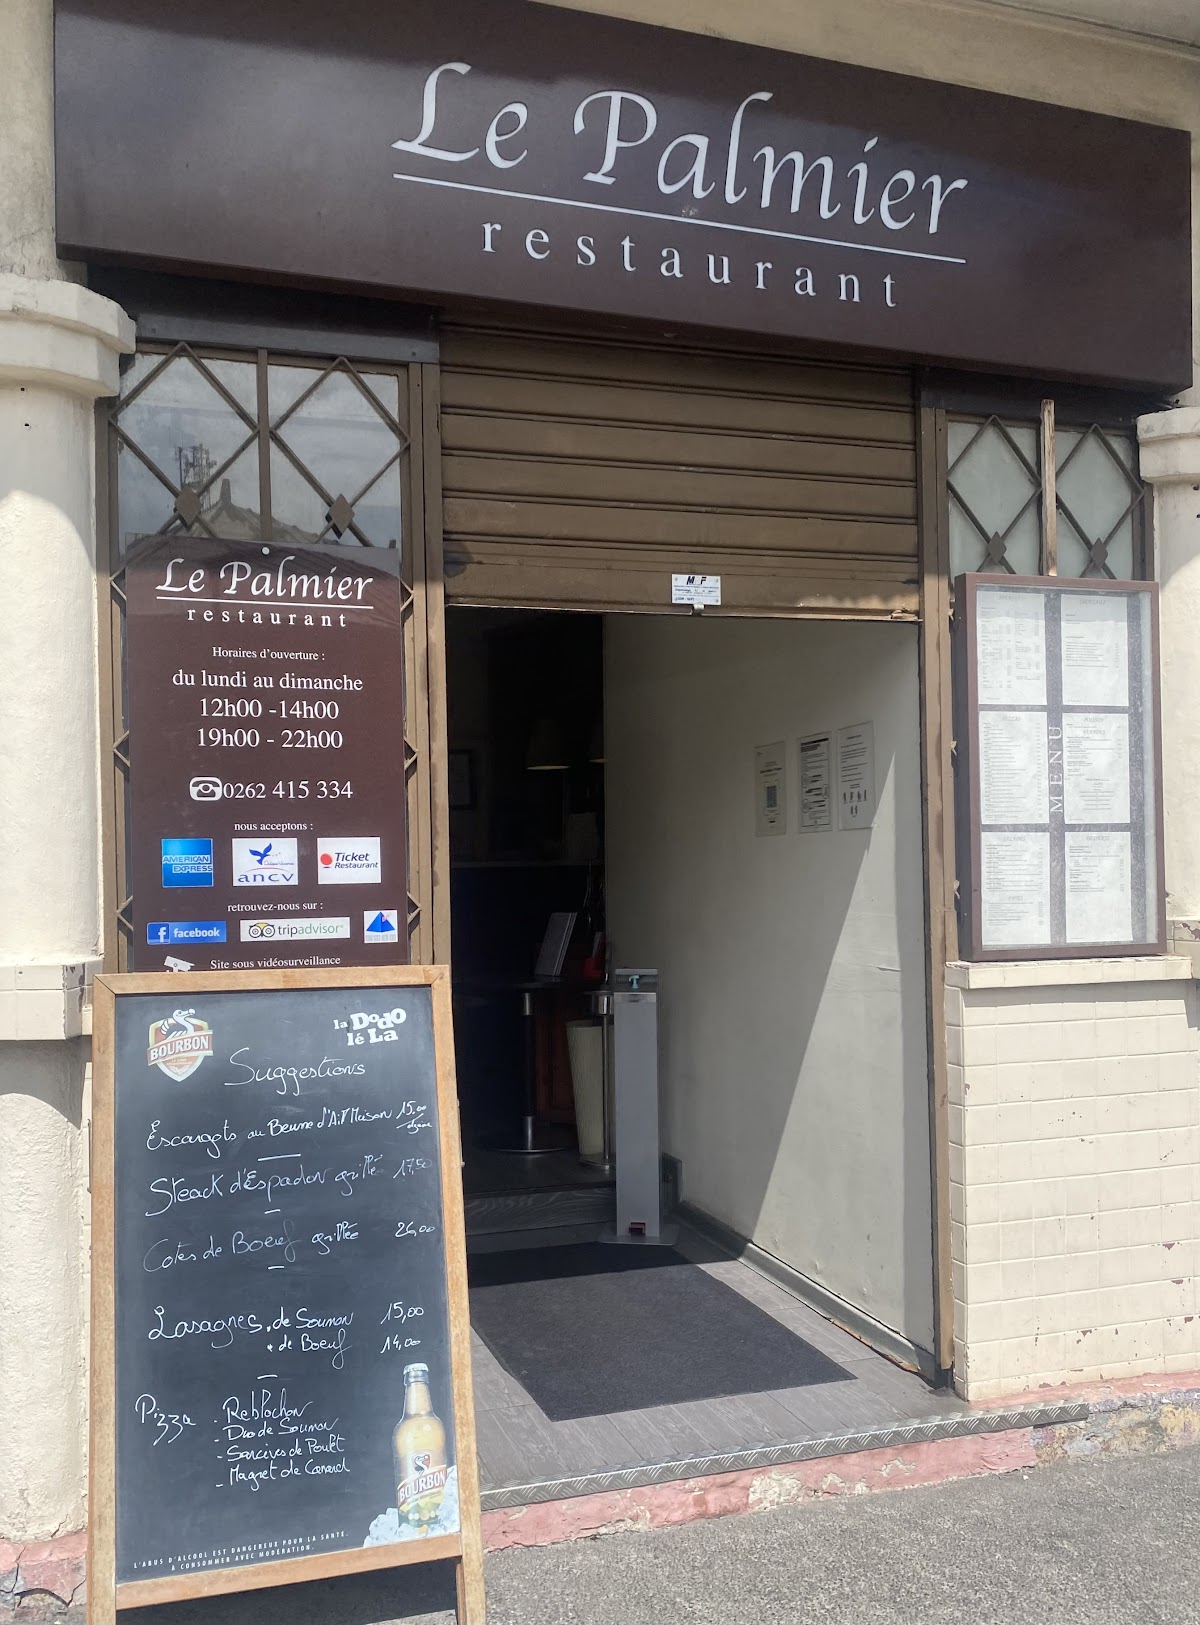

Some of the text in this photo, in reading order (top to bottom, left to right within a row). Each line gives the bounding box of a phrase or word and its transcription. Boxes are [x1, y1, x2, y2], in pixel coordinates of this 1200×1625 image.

[390, 61, 969, 236] Le Palmier
[481, 218, 897, 309] restaurant
[155, 555, 374, 601] Le Palmier
[186, 608, 347, 628] restaurant
[212, 646, 258, 660] Horaires
[259, 648, 319, 661] d'ouverture
[172, 669, 364, 692] du lundi au dimanche
[199, 698, 263, 718] 12h00
[197, 728, 260, 748] 19h00
[281, 729, 343, 749] 22h00
[1048, 726, 1063, 814] MENU
[223, 780, 354, 800] 0262 415 334
[234, 821, 258, 831] nous
[260, 821, 308, 833] acceptons
[162, 855, 210, 863] AMERICAN
[334, 852, 370, 863] Ticket
[334, 861, 379, 869] Restaurant
[237, 873, 295, 883] ancv
[227, 902, 300, 912] retrouvez-nous
[302, 902, 317, 910] sur
[173, 926, 220, 938] facebook
[210, 956, 341, 970] Site sous vidéosurveillance
[333, 1019, 348, 1030] la
[347, 1027, 399, 1046] lé La
[150, 1035, 209, 1061] BOURBON
[224, 1047, 366, 1096] Suggestions
[146, 1119, 237, 1159] Escargots
[247, 1129, 266, 1139] au
[144, 1173, 224, 1217] Steack
[202, 1235, 223, 1260] de
[232, 1219, 302, 1263] Boeuf
[148, 1305, 263, 1349] Lasagnes
[272, 1306, 292, 1329] de
[278, 1334, 293, 1351] de
[300, 1328, 352, 1370] Boeuf
[134, 1387, 314, 1446] Pizza Reblochon
[257, 1420, 274, 1438] de
[288, 1438, 302, 1457] de
[229, 1460, 278, 1491] Magret
[280, 1458, 301, 1478] de
[400, 1469, 446, 1503] BOURBON
[133, 1558, 163, 1569] L'ABUS
[168, 1551, 208, 1564] D'ALCOOL
[212, 1548, 227, 1557] EST
[231, 1541, 278, 1554] DANGEREUX
[282, 1537, 303, 1546] POUR
[307, 1535, 316, 1543] LA
[180, 1556, 231, 1570] CONSOMMER
[234, 1552, 255, 1562] AVEC
